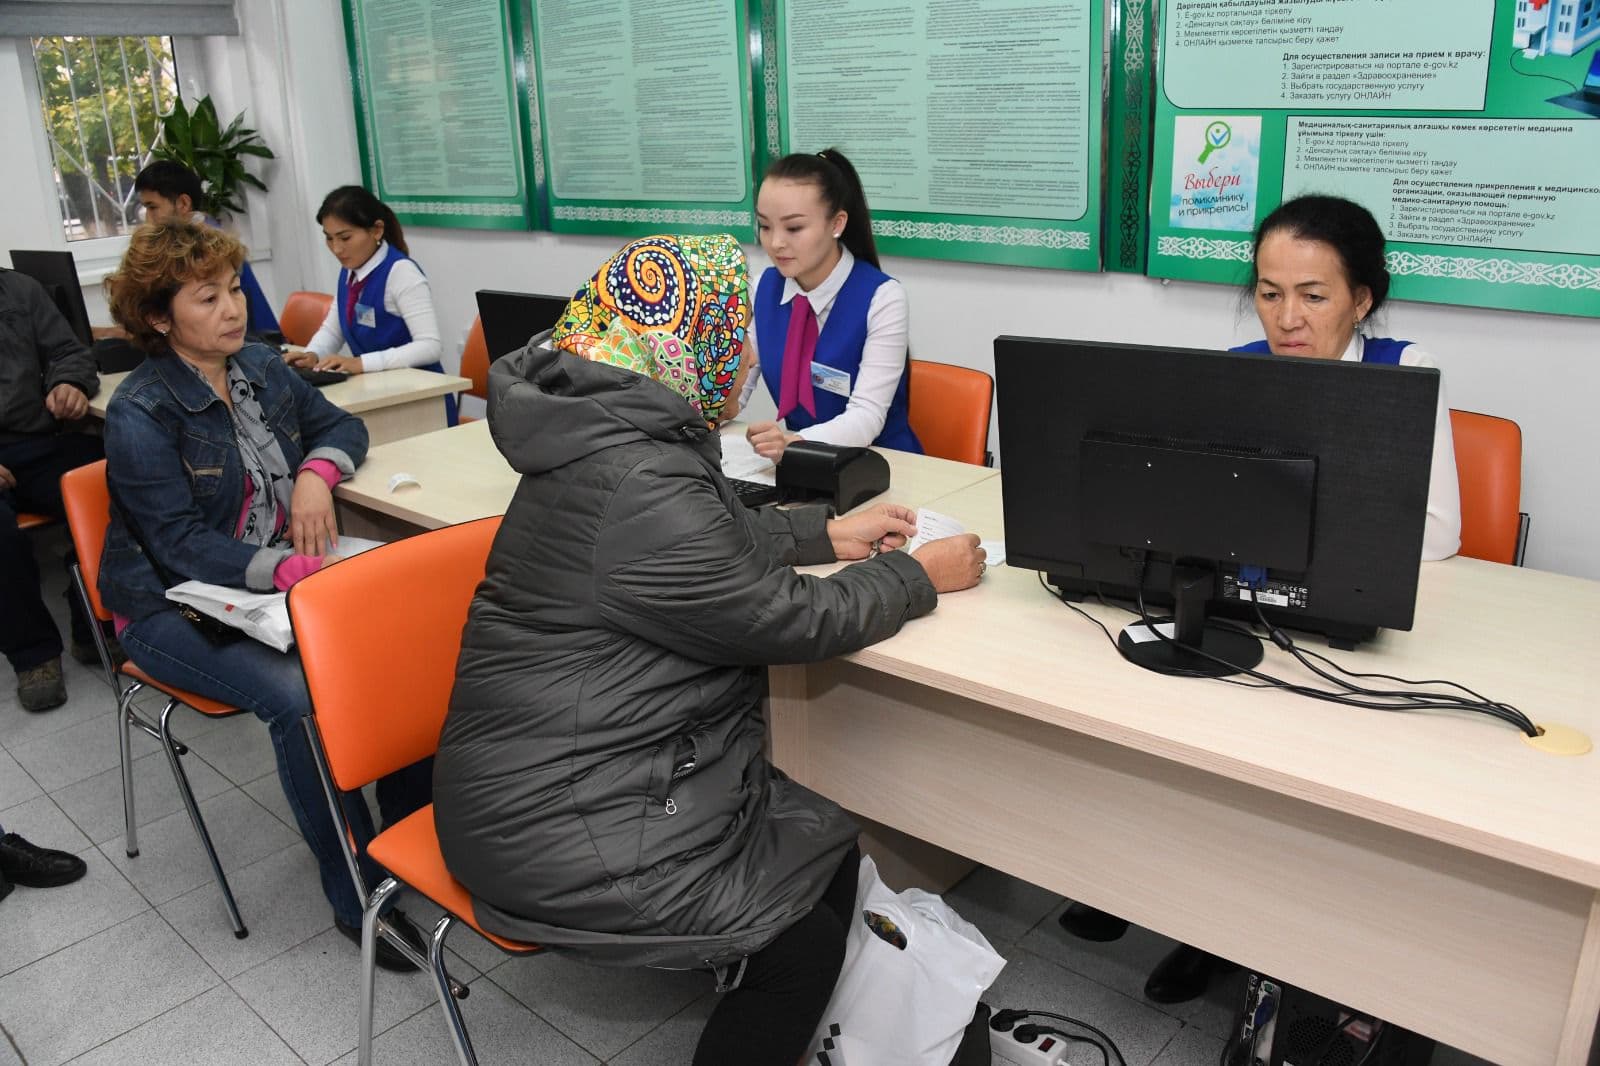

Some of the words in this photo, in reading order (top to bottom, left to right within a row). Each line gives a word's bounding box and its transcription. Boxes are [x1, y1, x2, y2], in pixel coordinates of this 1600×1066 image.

[1175, 21, 1182, 29] 2.
[1184, 38, 1217, 47] ОНЛАЙН
[1295, 36, 1314, 44] беру
[1283, 53, 1299, 61] Для
[1301, 52, 1367, 61] осуществления
[1416, 51, 1445, 59] прием
[1455, 51, 1486, 59] врачу:
[1423, 61, 1458, 70] e-gov.kz
[1291, 72, 1314, 80] Зайти
[1353, 72, 1437, 80] «Здравоохранение»
[1290, 82, 1324, 90] Выбрать
[1353, 91, 1391, 99] ОНЛАЙН
[1303, 163, 1335, 171] ОНЛАЙН
[1184, 166, 1241, 195] Выбери
[1393, 178, 1409, 186] Для
[1410, 180, 1473, 188] осуществления
[1182, 193, 1244, 206] поликлинику
[1392, 188, 1445, 196] организации,
[1447, 191, 1505, 199] оказывающей
[1507, 193, 1556, 202] первичную
[1392, 197, 1471, 207] медико-санитарную
[1474, 201, 1509, 209] помощь:
[1186, 202, 1248, 216] прикрепись!
[1400, 205, 1476, 214] Зарегистрироваться
[1489, 210, 1520, 218] портале
[1523, 212, 1555, 220] e-gov.kz
[1399, 213, 1420, 221] Зайти
[1457, 217, 1535, 227] «Здравоохранение»
[1398, 222, 1429, 230] Выбрать
[1431, 225, 1496, 235] государственную
[1499, 229, 1523, 237] услугу
[1397, 230, 1429, 238] Заказать
[1431, 233, 1455, 241] услугу
[1457, 234, 1492, 243] ОНЛАЙН
